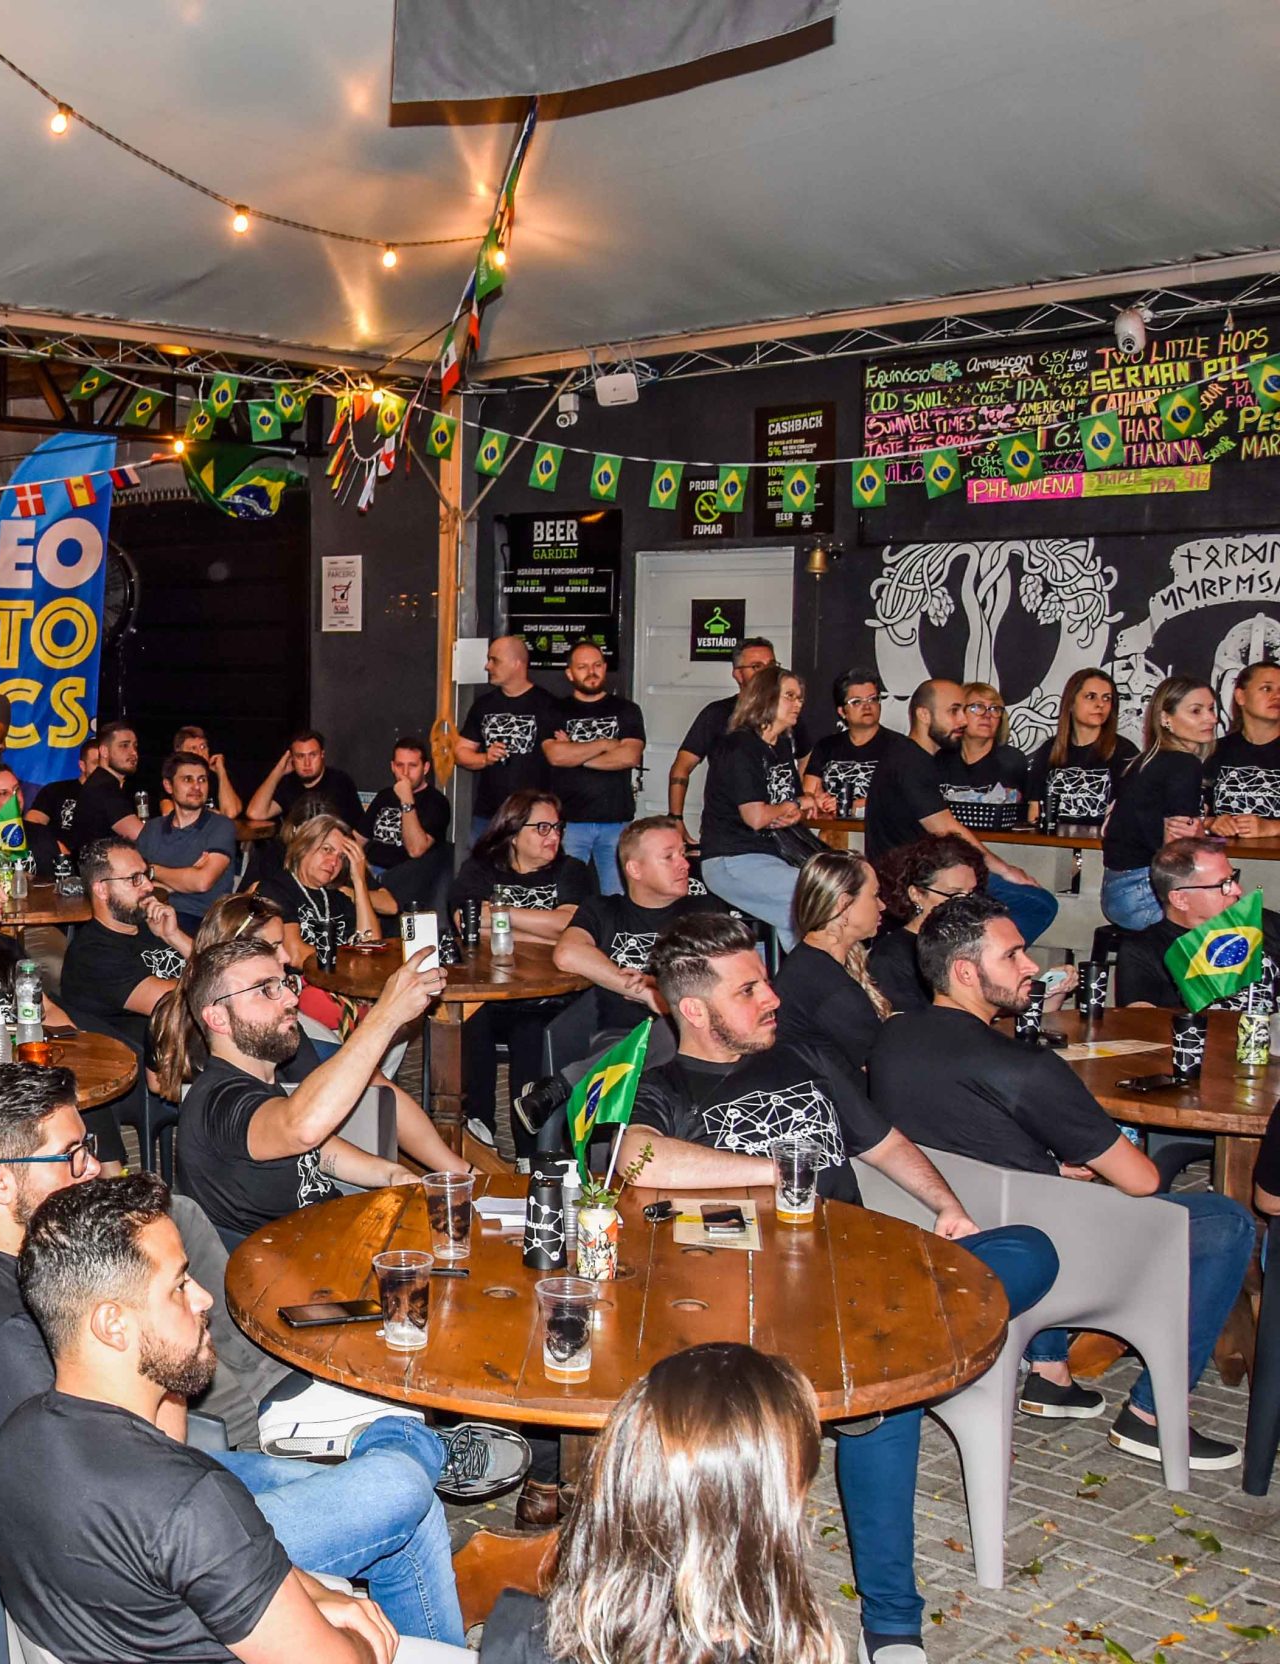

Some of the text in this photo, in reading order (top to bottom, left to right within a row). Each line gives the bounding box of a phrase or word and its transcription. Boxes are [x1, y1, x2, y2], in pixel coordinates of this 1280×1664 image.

[1151, 336, 1211, 364] LITTLE
[1218, 327, 1270, 355] HOPS
[1090, 352, 1268, 392] GERMAN PIL
[1016, 378, 1048, 401] IPA
[1090, 386, 1182, 417] CATHAR
[1225, 394, 1259, 409] FRA
[768, 415, 823, 436] CASHBACK
[867, 411, 976, 436] SUMMER TIMES
[1240, 433, 1280, 461] MAR
[689, 479, 718, 492] PROIBI
[973, 475, 1076, 503] PHENOMENA
[533, 519, 579, 542] BEER
[692, 523, 723, 535] FUMAR
[533, 547, 578, 560] GARDEN
[697, 635, 737, 647] VESTIÁRIO
